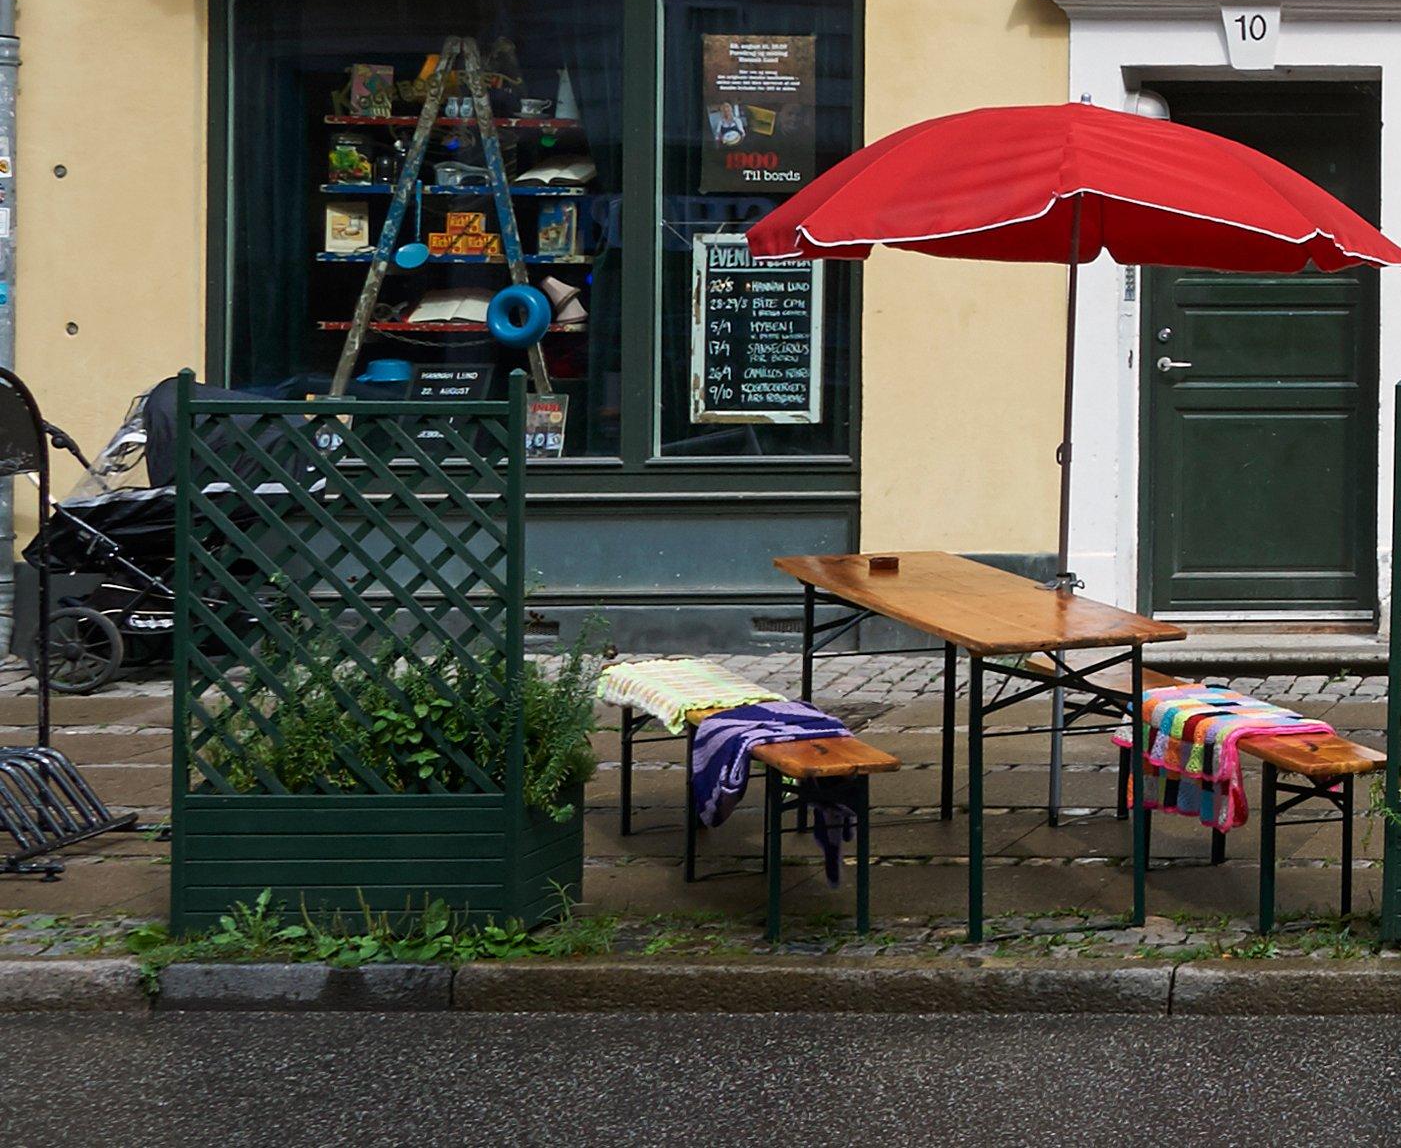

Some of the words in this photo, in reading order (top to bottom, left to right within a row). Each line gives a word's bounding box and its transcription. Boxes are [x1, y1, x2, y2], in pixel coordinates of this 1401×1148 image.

[1235, 15, 1266, 41] 10
[743, 170, 761, 181] Til
[763, 170, 801, 182] bords
